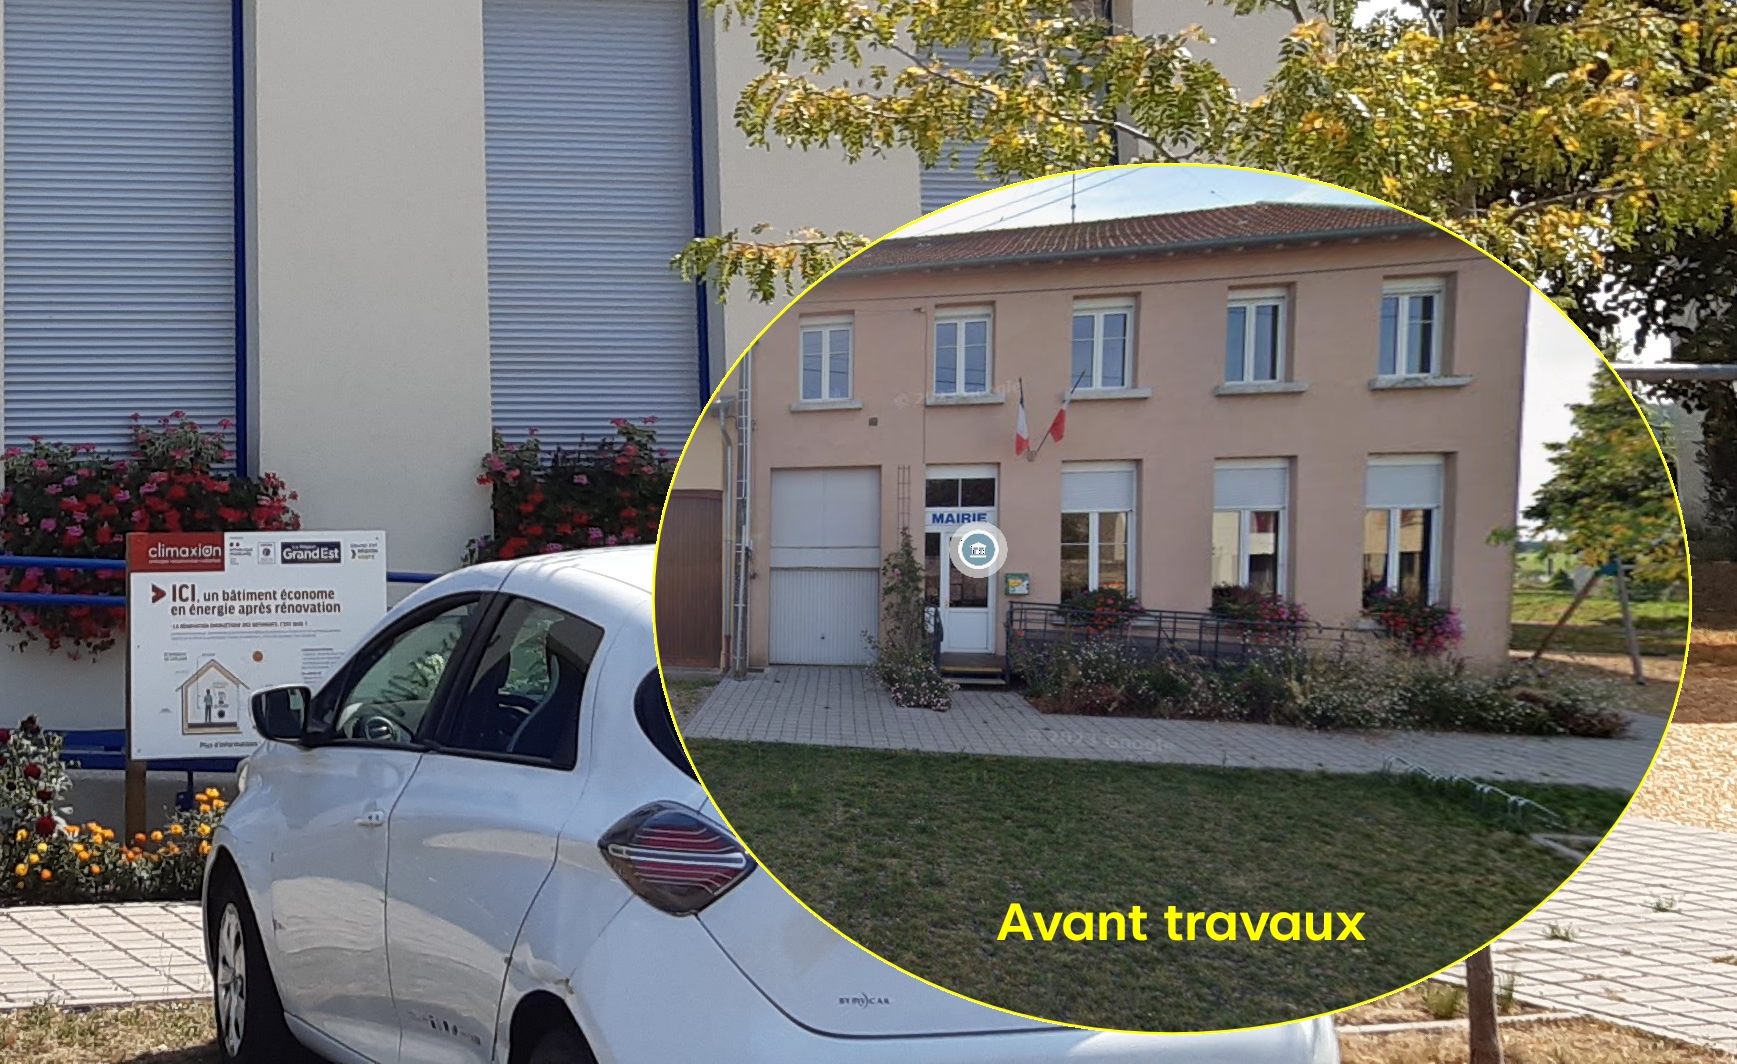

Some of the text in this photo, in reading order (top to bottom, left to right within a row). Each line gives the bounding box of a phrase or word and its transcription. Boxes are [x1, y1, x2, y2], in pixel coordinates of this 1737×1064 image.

[932, 513, 987, 524] MAIRIE
[148, 541, 222, 558] climaxion
[171, 584, 335, 603] ICI, un bâtiment économe
[171, 601, 341, 617] en énergie après rénovation
